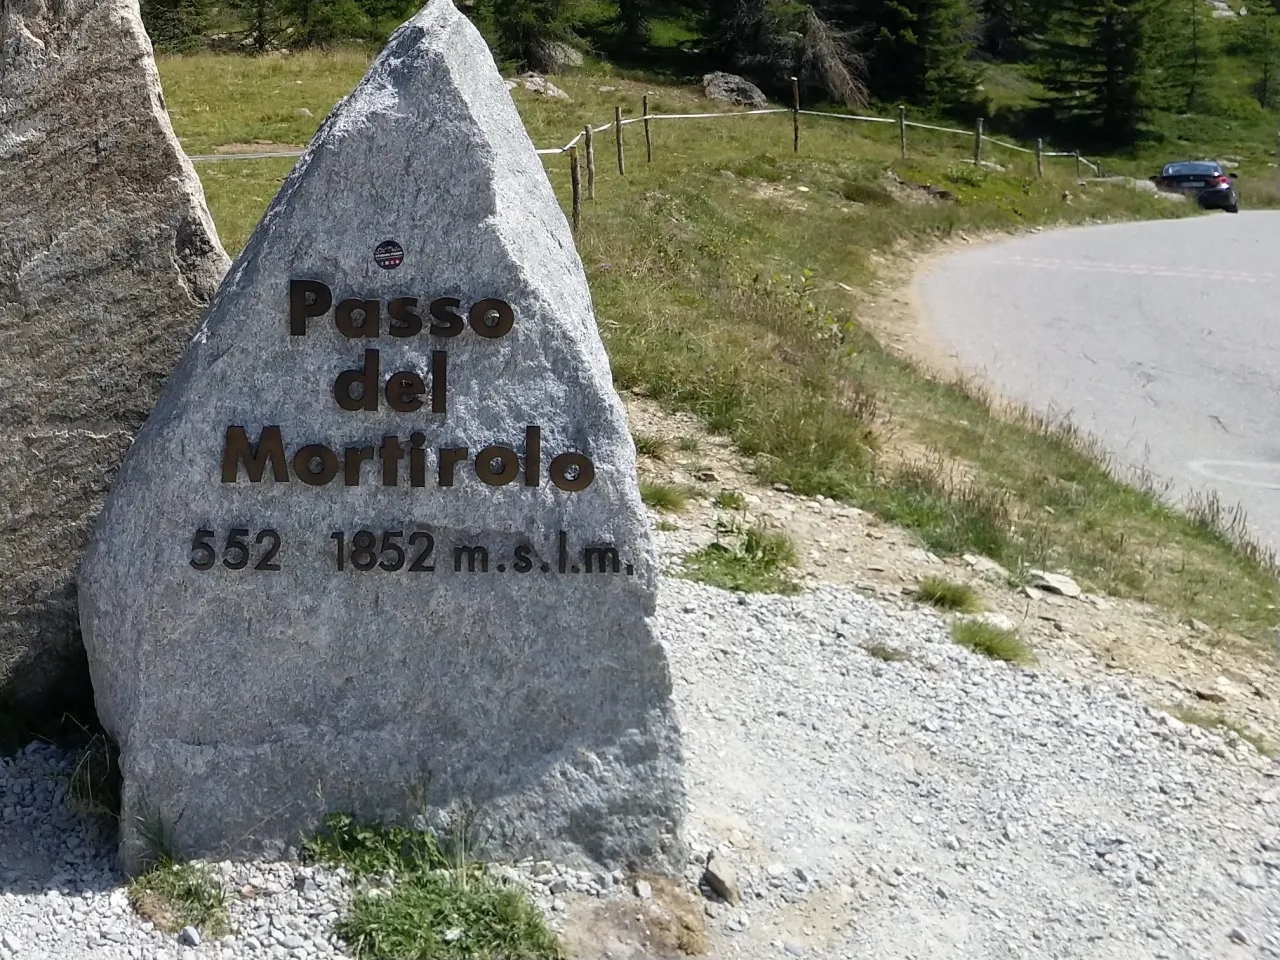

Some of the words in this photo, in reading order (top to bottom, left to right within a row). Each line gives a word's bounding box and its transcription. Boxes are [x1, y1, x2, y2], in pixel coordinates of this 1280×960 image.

[289, 279, 515, 338] Passo
[333, 348, 448, 413] del
[220, 425, 596, 492] Mortirolo
[189, 528, 282, 572] 552
[330, 530, 437, 573] 1852
